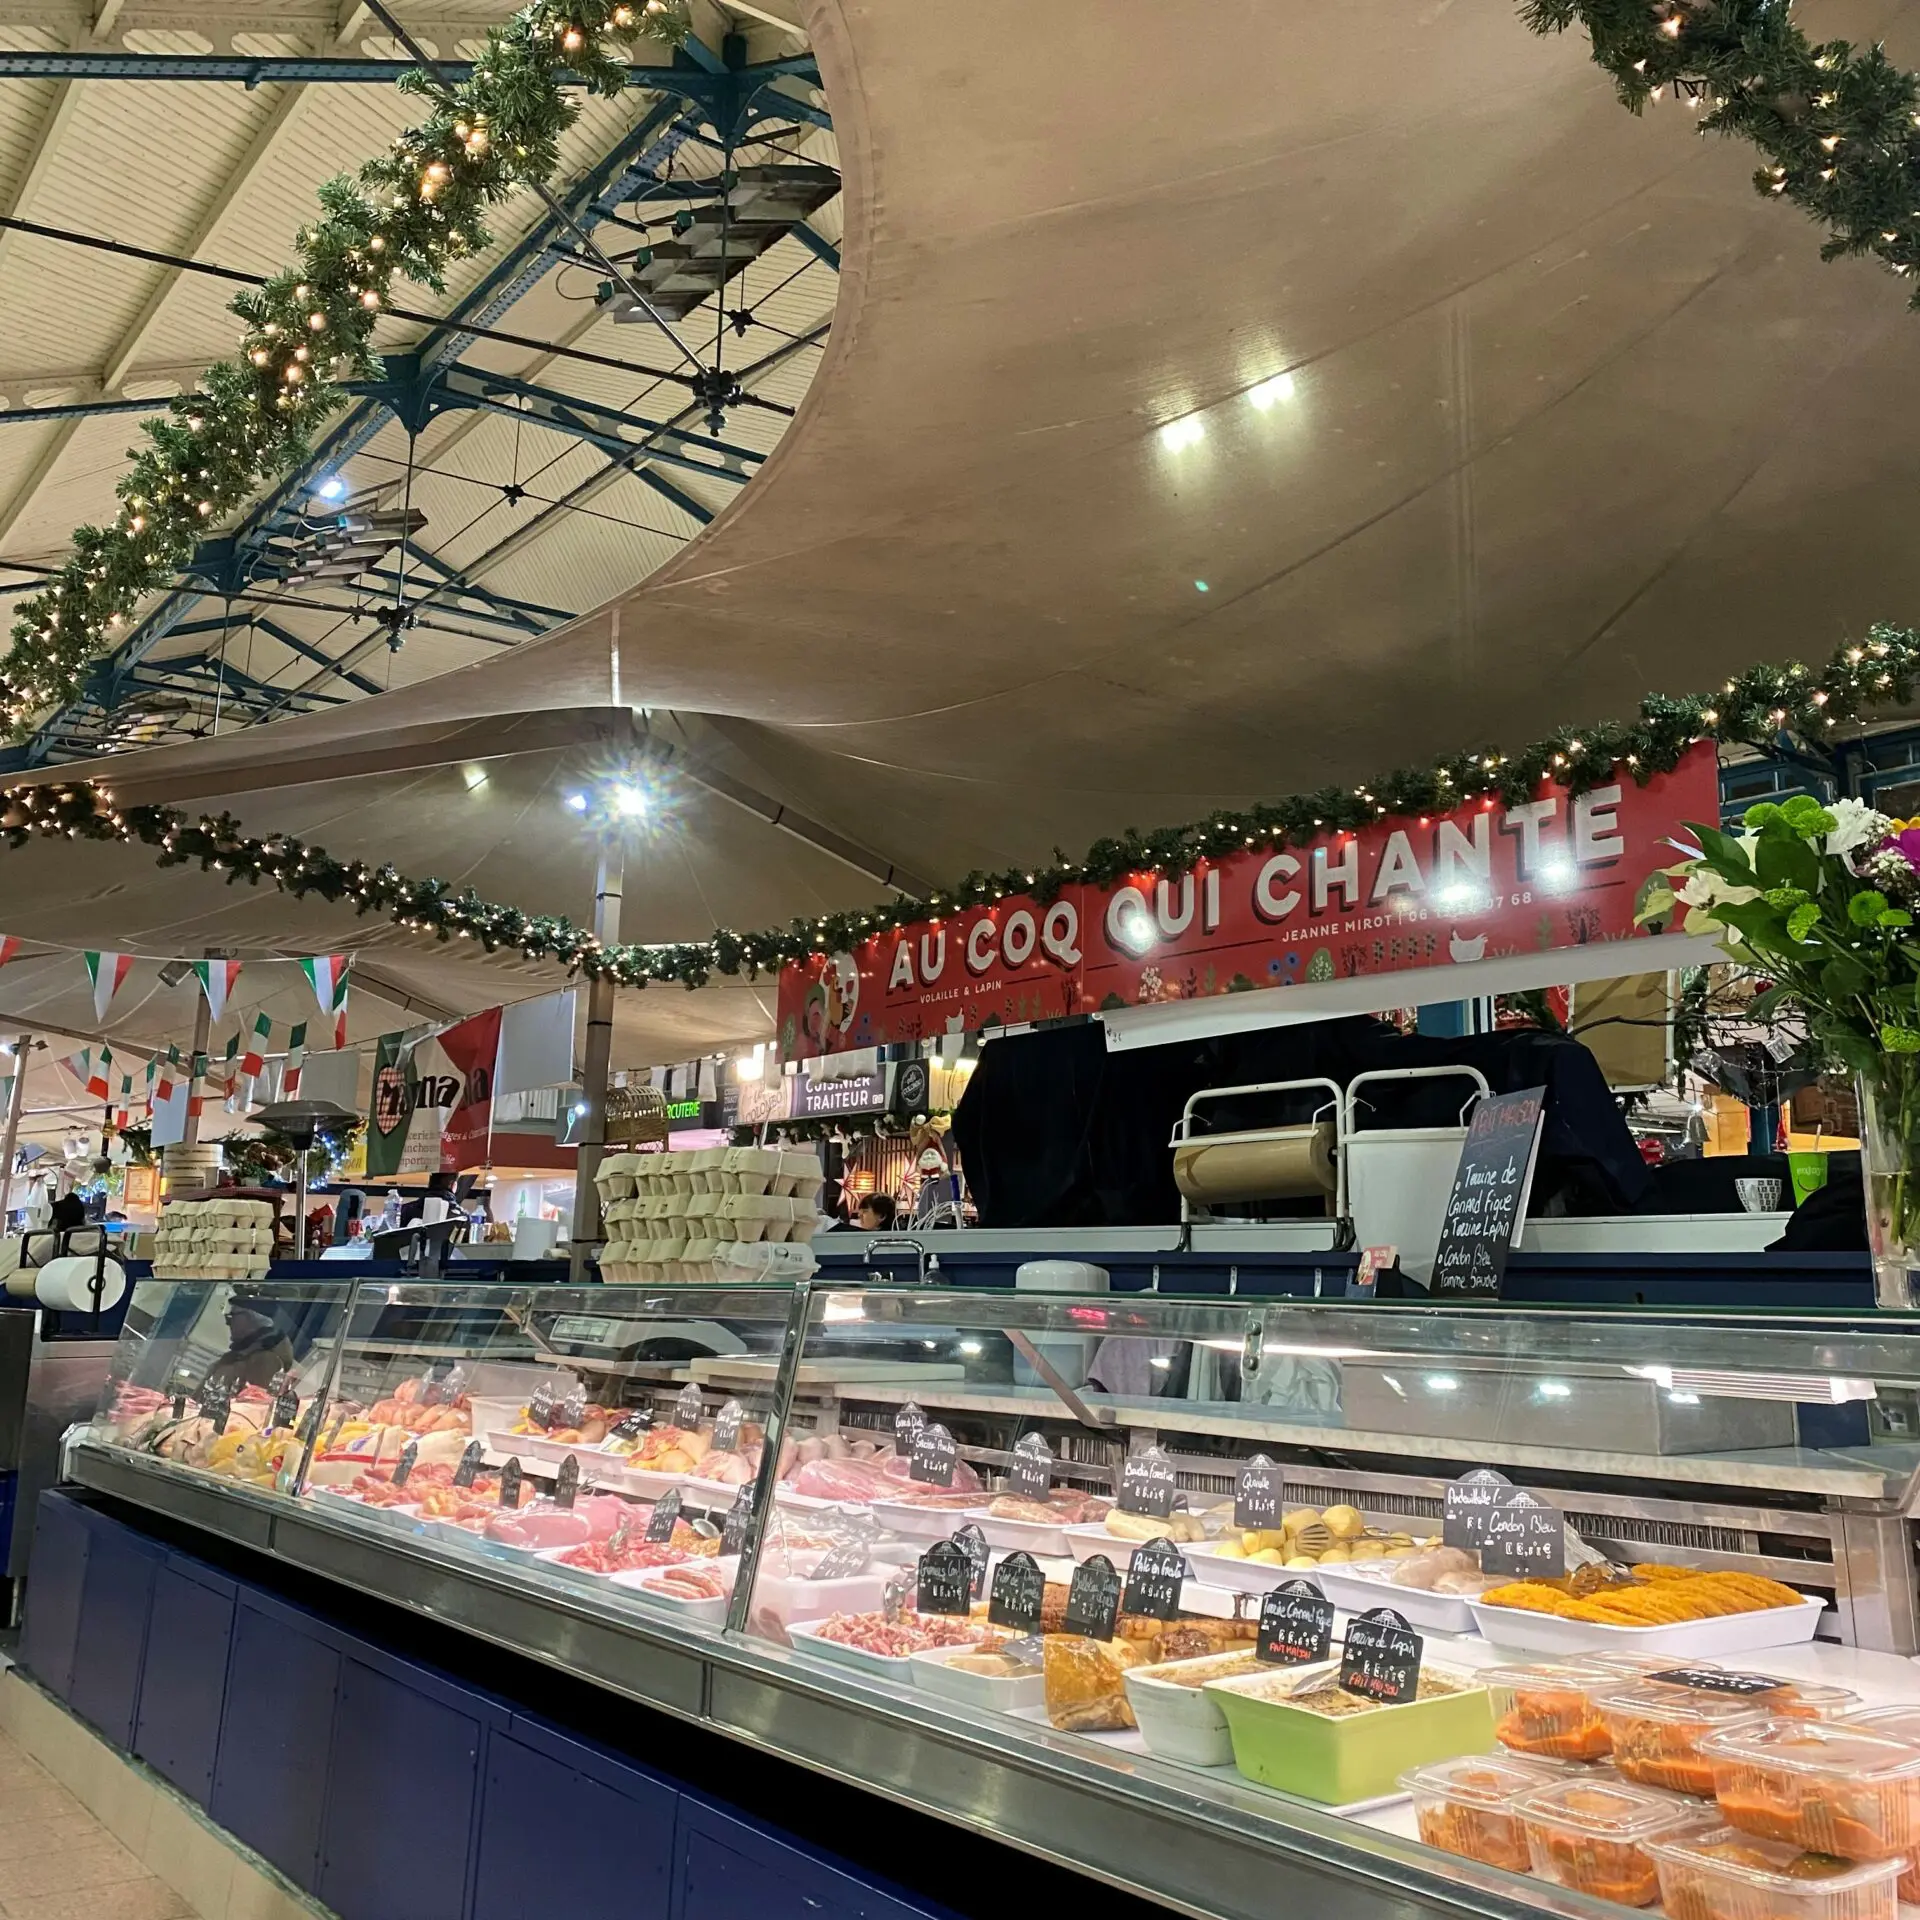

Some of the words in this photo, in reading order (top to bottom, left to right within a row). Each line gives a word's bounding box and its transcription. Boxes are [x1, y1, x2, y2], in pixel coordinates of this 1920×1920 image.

[887, 929, 946, 993] AU
[966, 900, 1083, 971] COQ
[1104, 868, 1220, 957] QUI
[1254, 784, 1625, 919] CHANTE
[1282, 923, 1339, 943] JEANNE
[1345, 914, 1391, 933] MIROT
[1409, 908, 1427, 922] 06
[1511, 891, 1532, 905] 68
[920, 988, 959, 1004] VOLAILLE
[975, 980, 1002, 995] LAPIN
[666, 1101, 701, 1119] RCUTERIE
[806, 1090, 868, 1111] TRAITEUR
[1501, 1155, 1517, 1184] de
[1489, 1511, 1525, 1534] Cordon
[1530, 1514, 1557, 1534] Bleu
[1375, 1628, 1388, 1649] de
